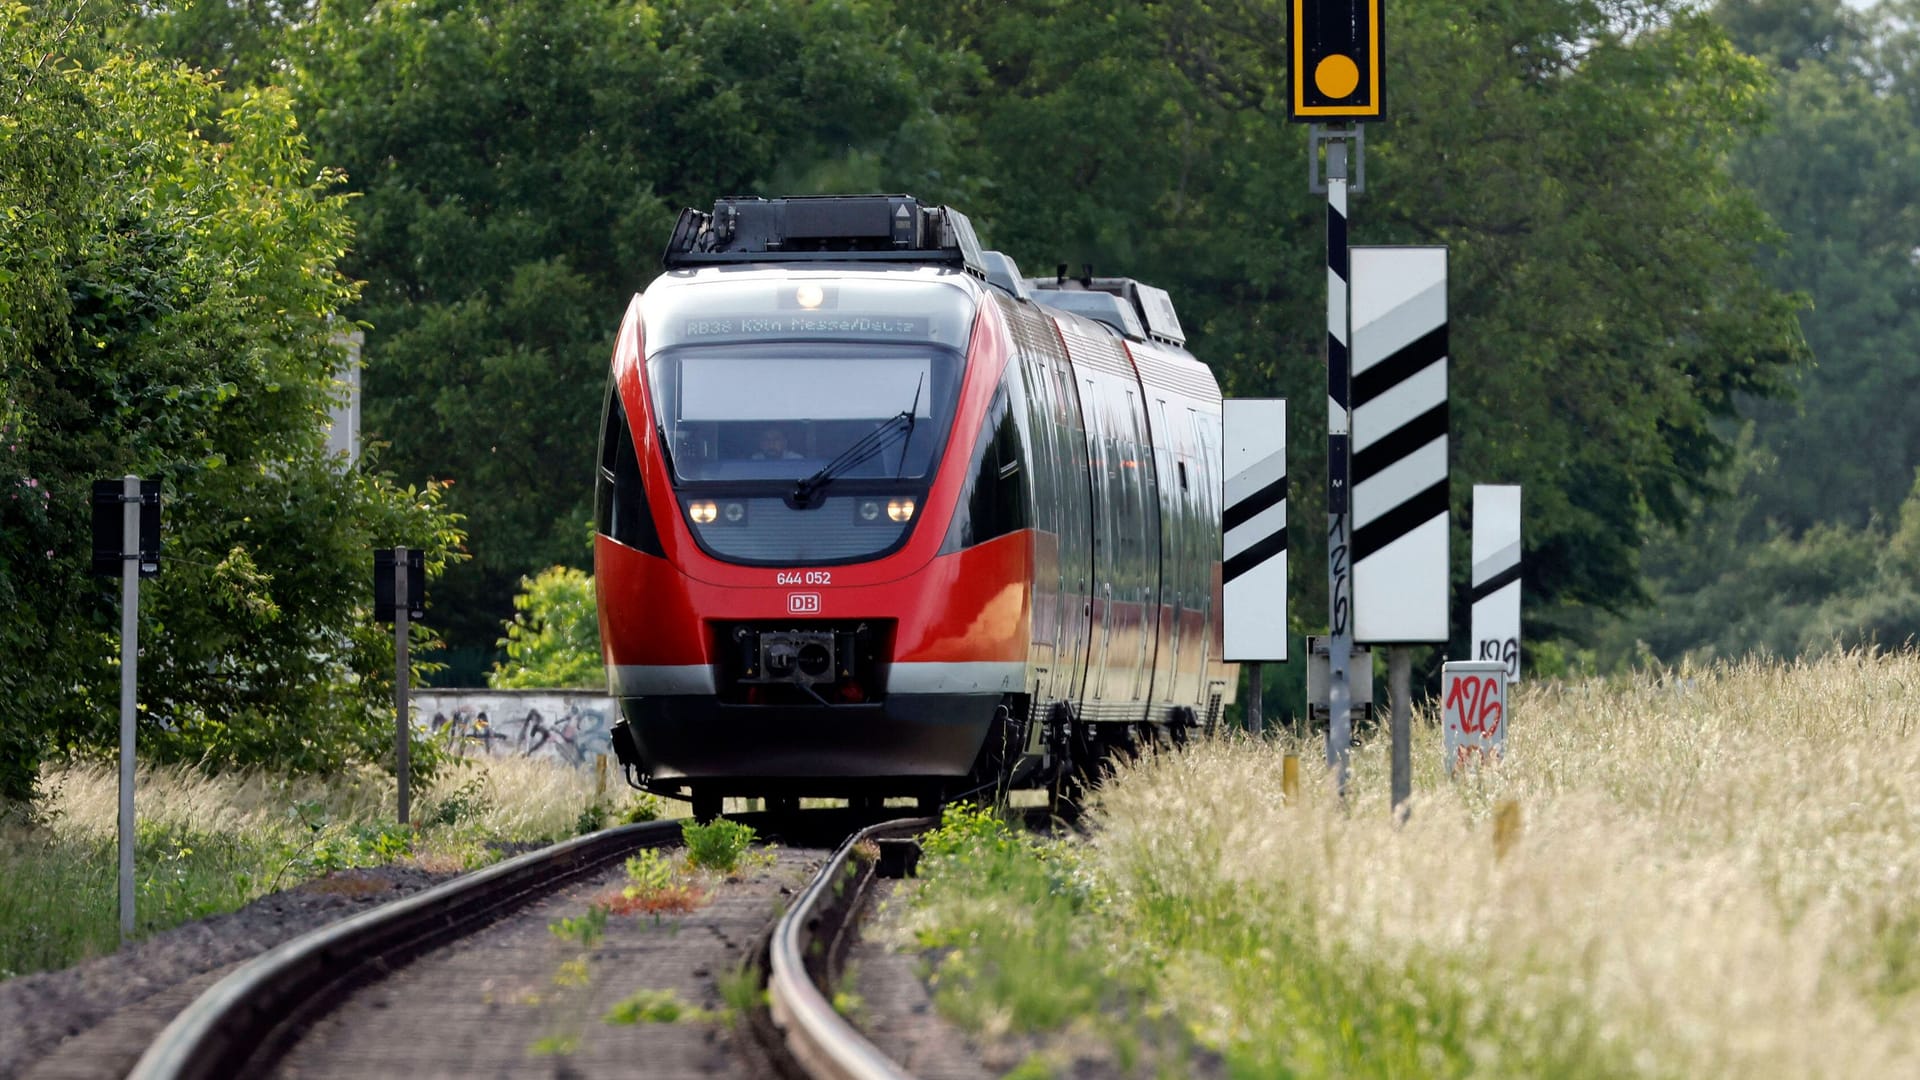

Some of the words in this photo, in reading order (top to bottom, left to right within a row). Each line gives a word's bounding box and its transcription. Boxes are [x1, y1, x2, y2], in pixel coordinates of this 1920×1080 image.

[777, 572, 802, 585] 644
[805, 571, 831, 584] 052
[1329, 513, 1347, 635] 126
[791, 595, 818, 611] DB
[1446, 675, 1502, 738] 126
